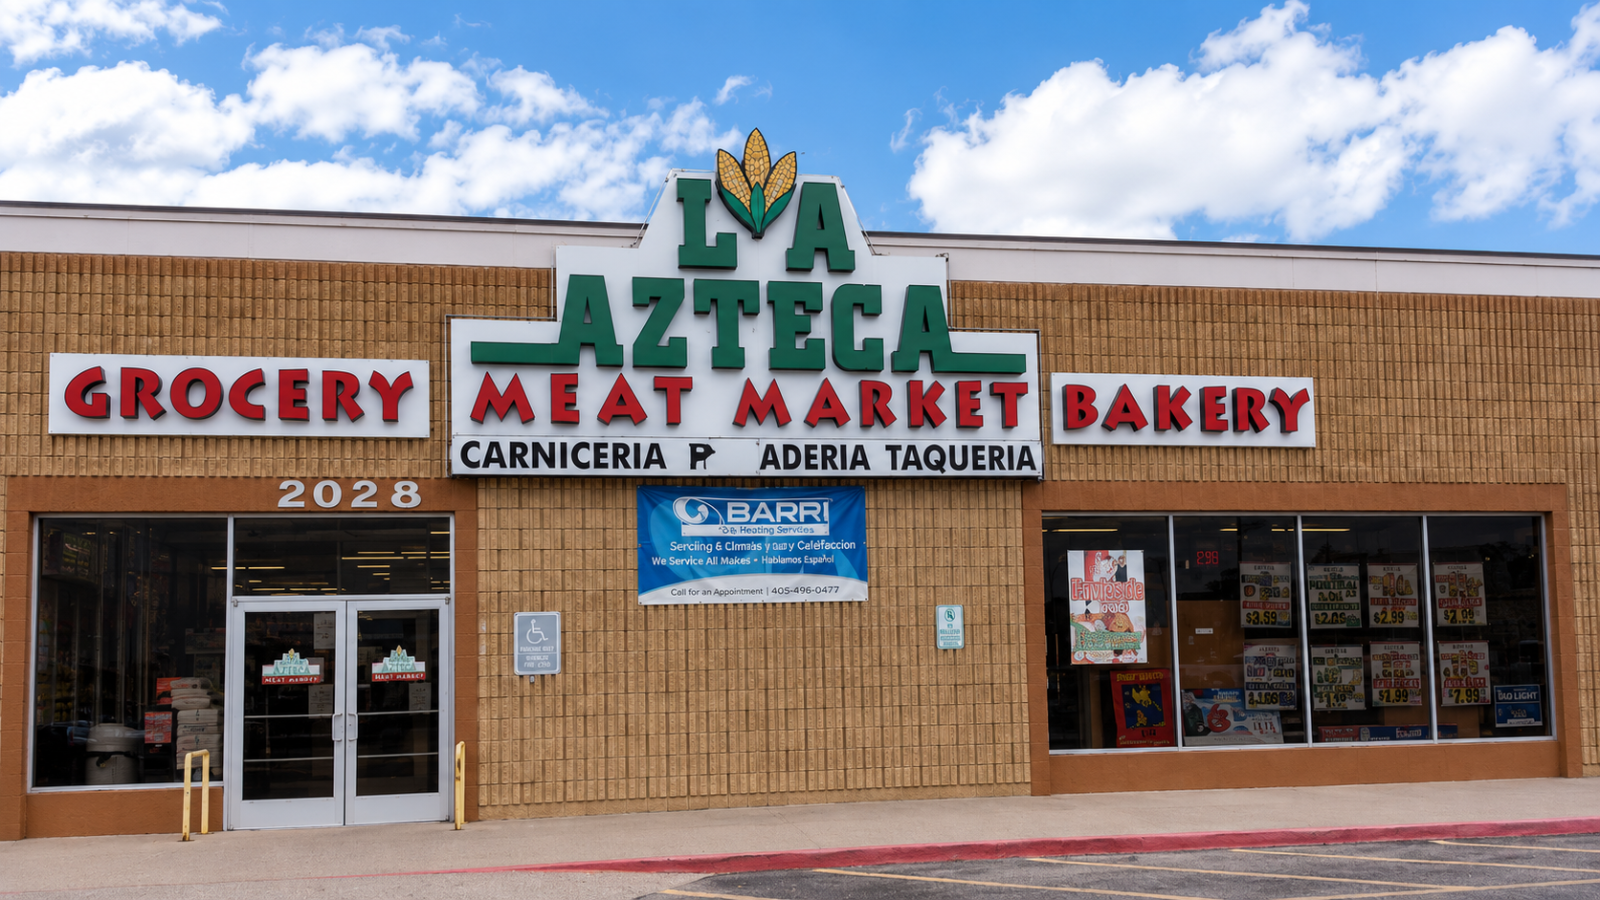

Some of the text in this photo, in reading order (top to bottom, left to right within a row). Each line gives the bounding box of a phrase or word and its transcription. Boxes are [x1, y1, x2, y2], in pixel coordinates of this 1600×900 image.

[470, 274, 1027, 374] AZTECA
[64, 365, 414, 423] GROCERY
[470, 371, 1028, 429] MEAT MARKET
[1061, 383, 1311, 433] BAKERY
[460, 440, 667, 469] CARNICERIA
[885, 444, 1037, 474] TAQUERIA
[277, 479, 422, 508] 2028
[727, 501, 828, 523] BARRI
[652, 556, 667, 566] We
[669, 556, 704, 566] Service
[706, 556, 718, 565] All
[720, 556, 751, 565] Makes
[761, 555, 802, 564] Hablamos
[671, 587, 686, 597] Call
[688, 588, 700, 596] for
[713, 587, 763, 597] Appointment
[771, 585, 840, 595] 405-496-0477
[1374, 610, 1405, 625] $2.99
